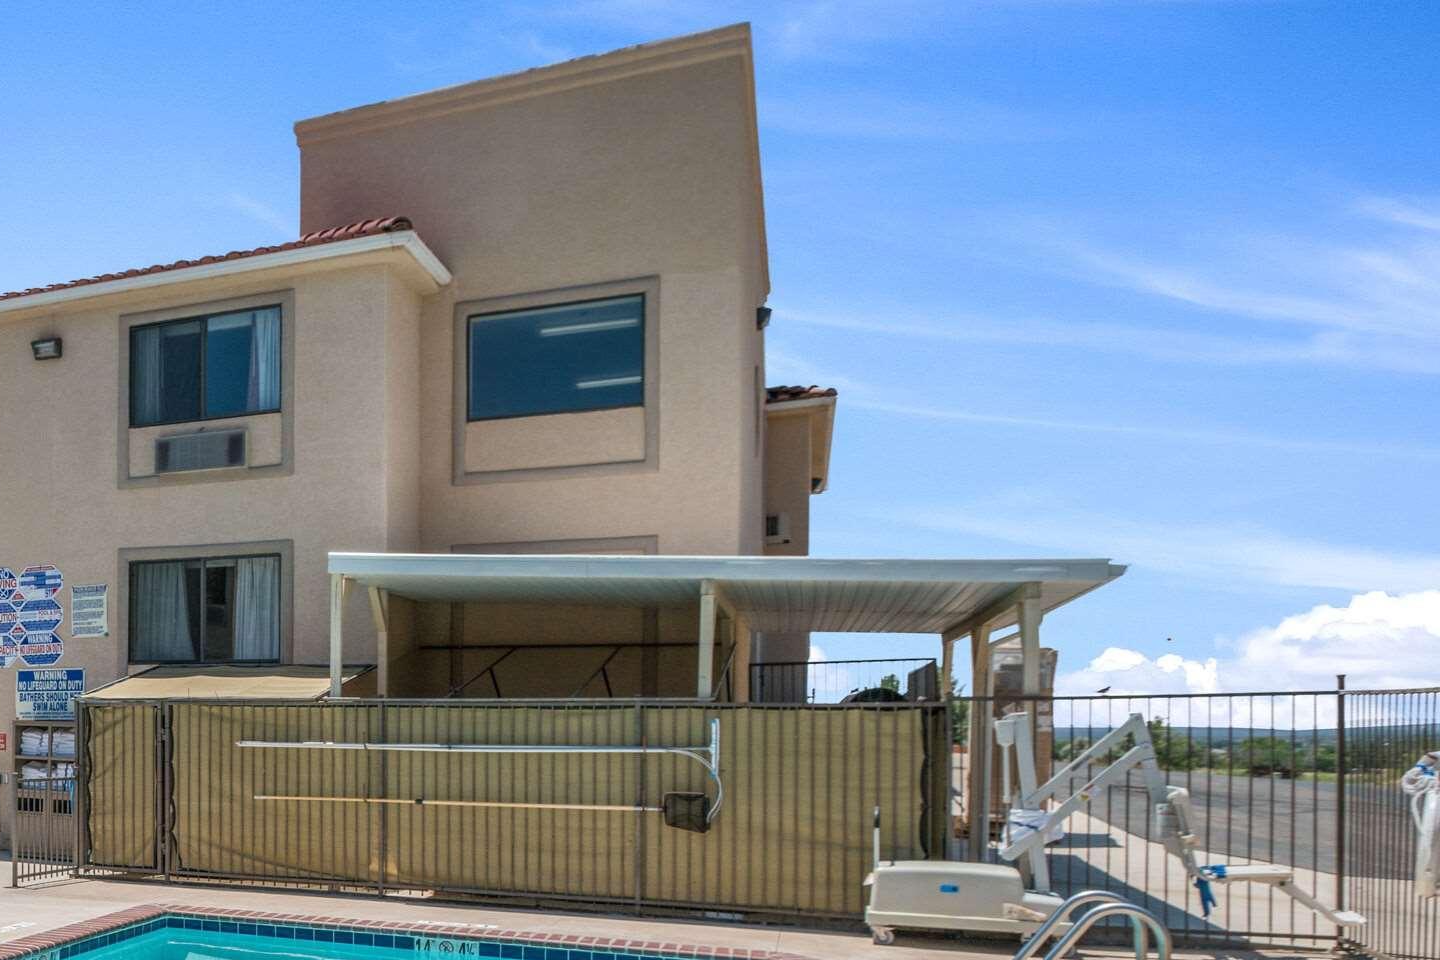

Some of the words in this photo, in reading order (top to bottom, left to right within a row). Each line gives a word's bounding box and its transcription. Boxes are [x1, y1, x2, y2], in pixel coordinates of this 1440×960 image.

[27, 632, 52, 643] WARNING
[33, 671, 68, 681] WARNING
[18, 681, 27, 690] NO
[27, 681, 58, 691] LIFEGUARD
[58, 681, 67, 690] ON
[68, 680, 82, 690] DUTY
[19, 692, 45, 702] BATHERS
[46, 692, 68, 701] SHOULD
[33, 702, 48, 711] SWIM
[49, 702, 68, 711] ALONE
